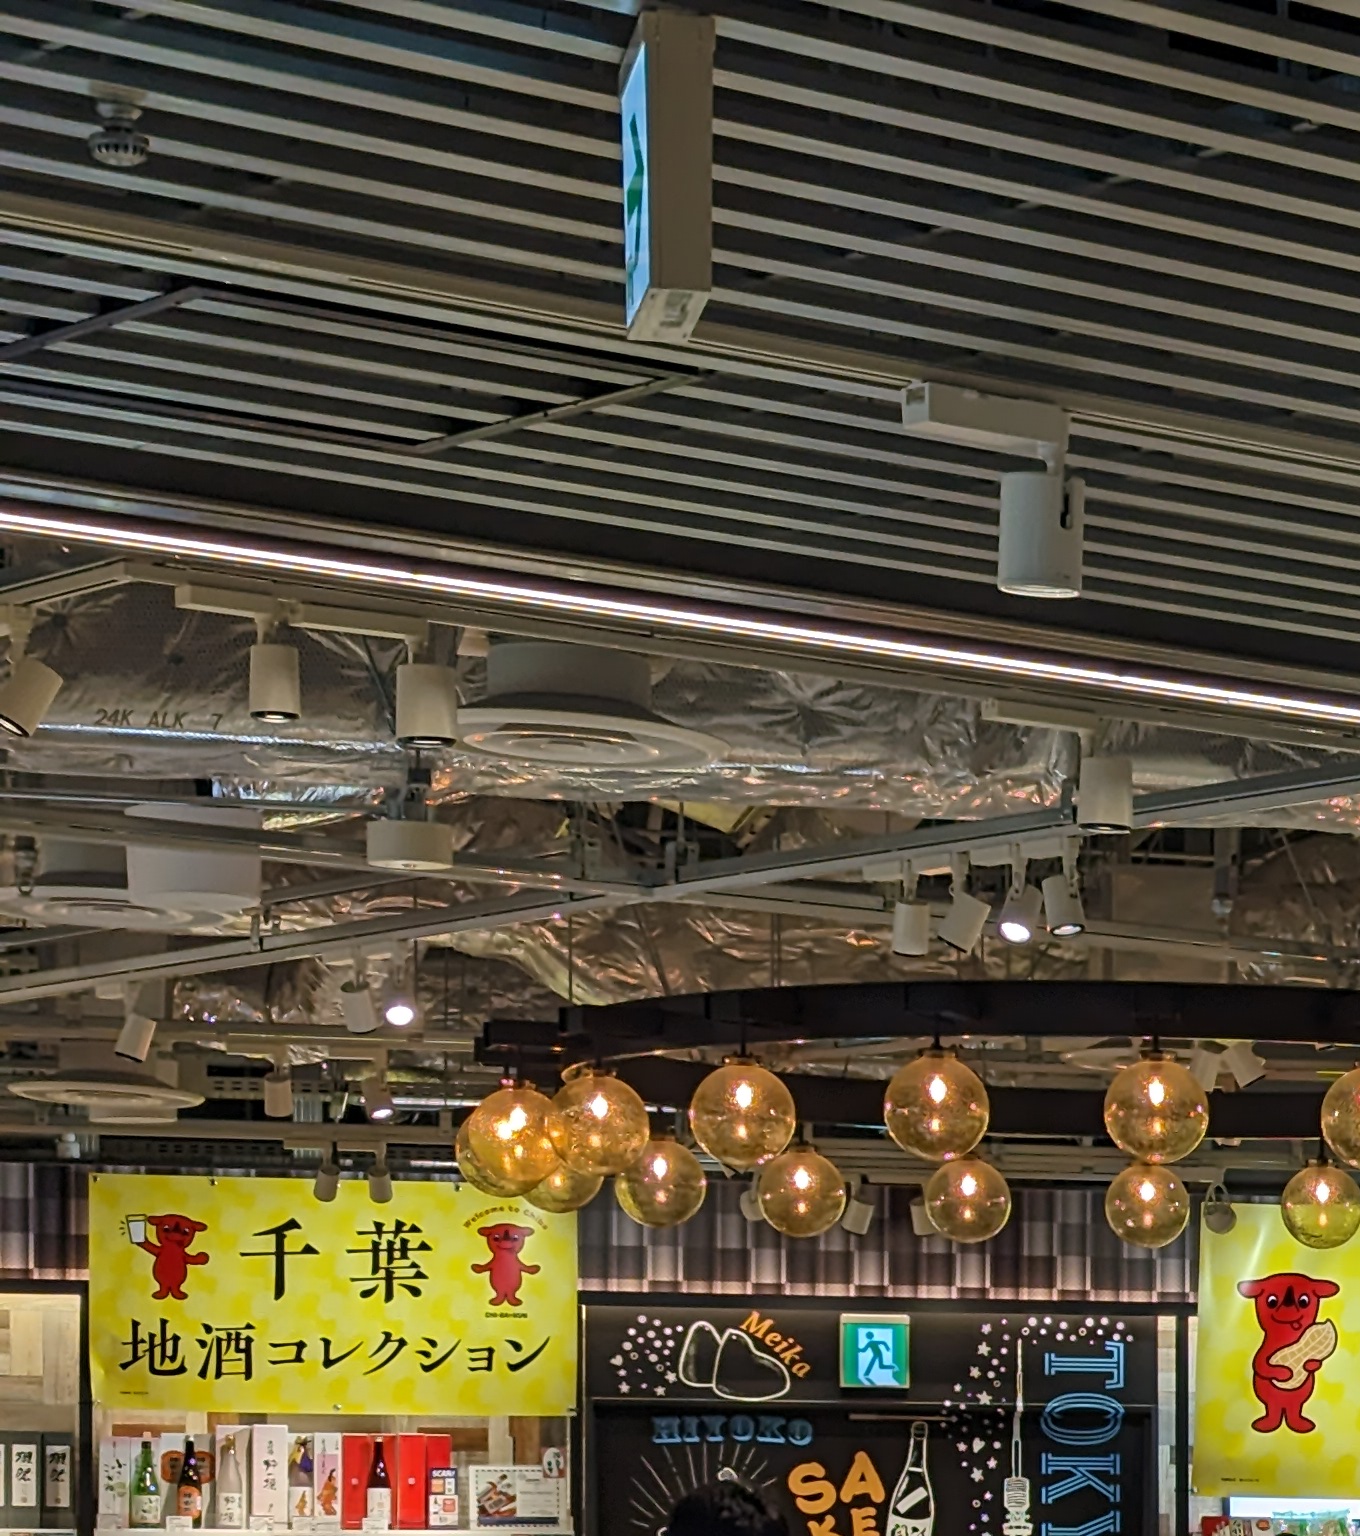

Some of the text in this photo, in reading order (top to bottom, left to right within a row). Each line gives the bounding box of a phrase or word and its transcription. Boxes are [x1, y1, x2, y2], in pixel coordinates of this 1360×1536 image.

[239, 1217, 434, 1303] 千葉
[118, 1318, 552, 1382] 地酒コレクション
[739, 1310, 813, 1379] Meika
[651, 1414, 814, 1446] HIYOKO
